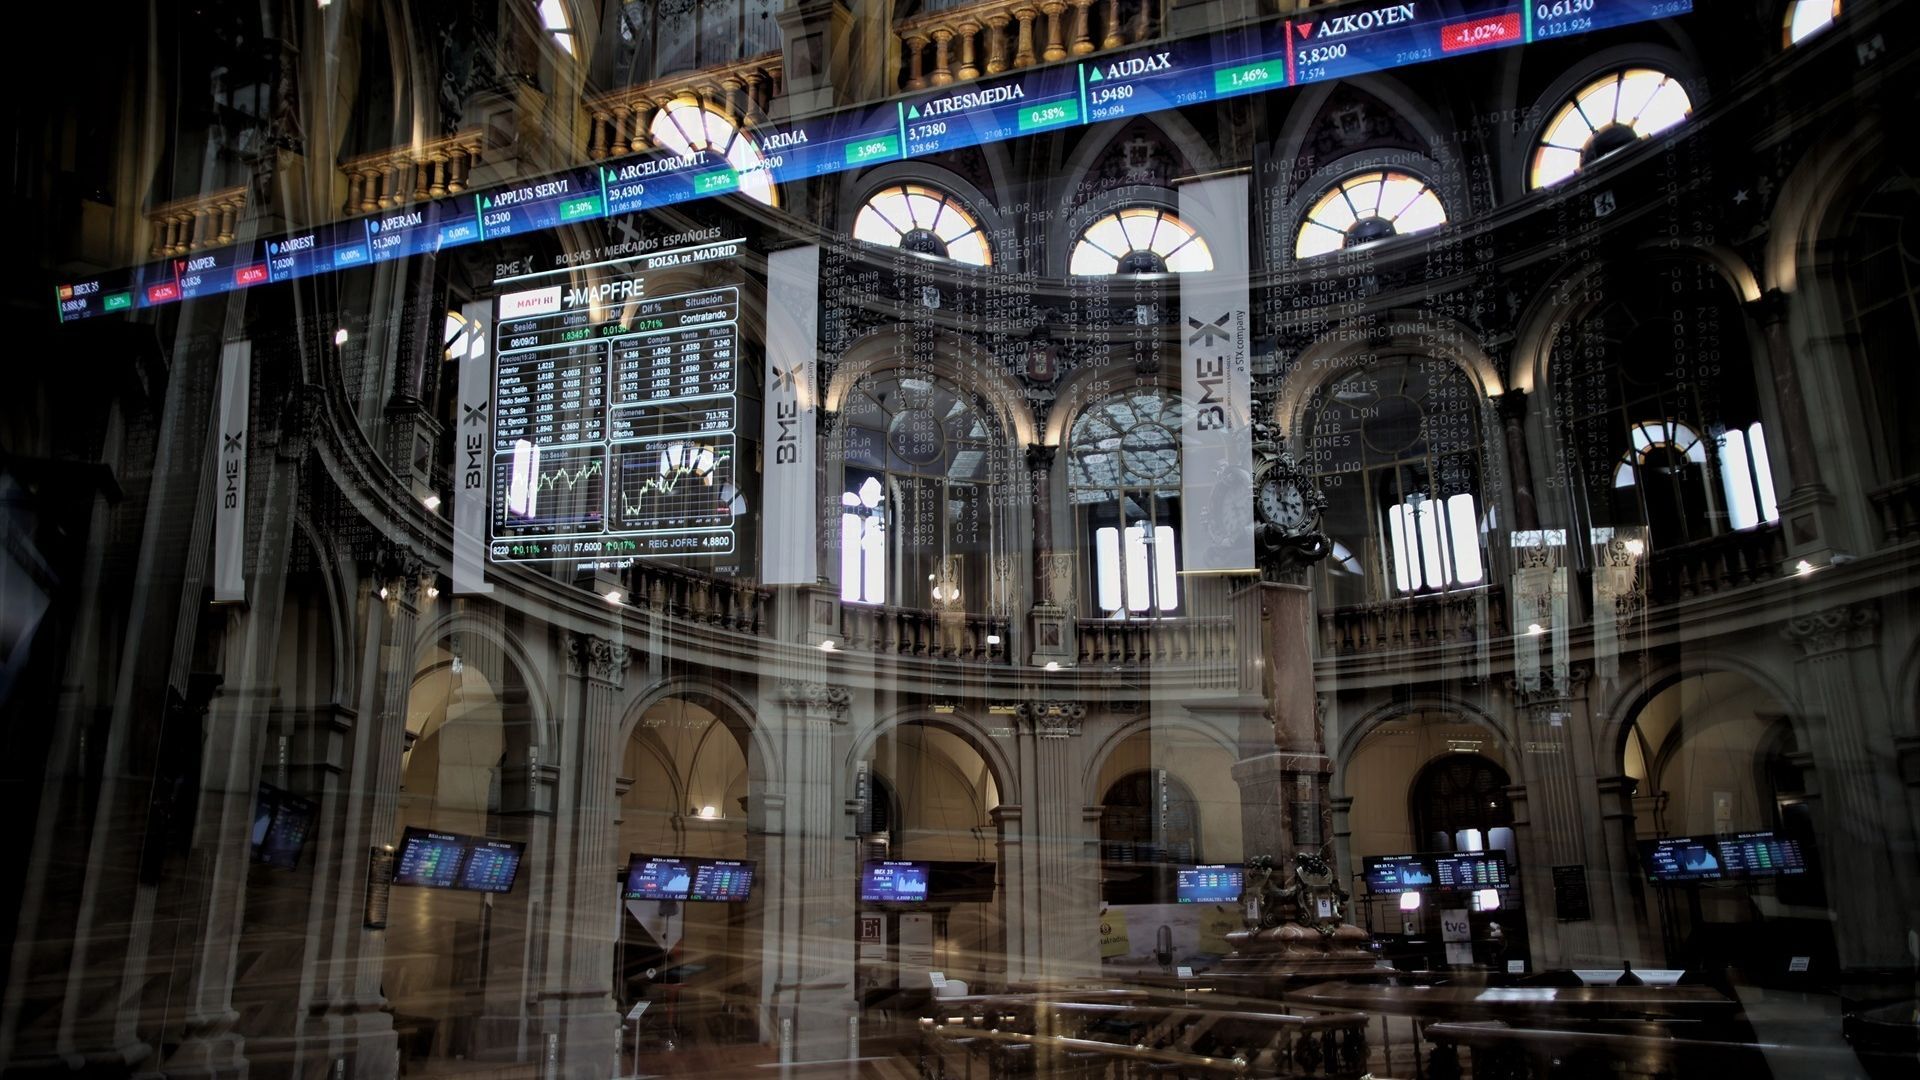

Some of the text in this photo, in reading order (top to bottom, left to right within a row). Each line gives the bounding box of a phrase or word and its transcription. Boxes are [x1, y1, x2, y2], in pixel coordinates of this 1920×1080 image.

[1317, 3, 1415, 38] AZKOYEN
[1538, 18, 1592, 37] 6.121.924
[1456, 22, 1505, 43] -1,02%
[1299, 44, 1347, 65] 5,8200
[1396, 48, 1432, 64] 27/08/21
[1107, 53, 1172, 79] AUDAX
[1231, 69, 1268, 86] 1,46%
[1300, 67, 1325, 81] 7.574
[922, 84, 1025, 117] ATRESMEDIA
[1091, 86, 1133, 105] 1,9480
[1176, 89, 1207, 103] 27/08/21
[1031, 107, 1065, 123] 0,38%
[1092, 104, 1125, 119] 399.094
[908, 122, 946, 140] 3,7380
[762, 129, 808, 151] ARIMA
[910, 140, 939, 154] 328.645
[857, 142, 886, 157] 3,96%
[1264, 155, 1315, 173] INDICE
[1282, 147, 1450, 182] INDICES NACIONALES
[704, 173, 730, 188] 2,74%
[493, 179, 569, 208] APPLUS SERVI
[608, 184, 644, 201] 29,4300
[1117, 187, 1139, 197] DIF
[568, 201, 592, 215] 2,30%
[993, 203, 1031, 216] VALOR
[380, 211, 423, 232] APERAM
[484, 212, 511, 227] 8,2300
[448, 226, 470, 239] 0,00%
[279, 235, 315, 253] AMREST
[372, 234, 401, 250] 51,2600
[555, 226, 722, 265] BOLSAS Y MERCADOS ESPAÑOLES
[340, 248, 360, 261] 0,00%
[648, 244, 738, 269] BOLSA MADRID
[1265, 250, 1375, 273] IBEX 35 ENER
[187, 256, 216, 272] AMPER
[272, 257, 294, 270] 7,0200
[496, 260, 520, 277] BME
[825, 267, 845, 276] CAF
[825, 271, 879, 287] CATALANA
[985, 270, 1038, 286] EDREAMS
[1265, 262, 1375, 286] IBEX 35 CONS
[575, 278, 645, 305] MAPFRE
[825, 283, 879, 298] COR ALBA
[1266, 275, 1375, 298] IBEX TOP DIV
[685, 295, 723, 307] Situación
[825, 294, 879, 308] DOMINION
[985, 295, 1031, 308] ERCROS
[1266, 290, 1367, 311] IB GROWTH15
[642, 305, 653, 314] Dif
[681, 310, 727, 323] Contratando
[985, 306, 1038, 321] EZENTIS
[1265, 302, 1367, 324] LATIBEX TOP
[513, 321, 537, 332] Sesión
[563, 314, 587, 326] Último
[985, 316, 1046, 332] GRENERGY
[1265, 314, 1376, 337] LATIBEX BRAS
[681, 332, 698, 340] Venta
[825, 325, 879, 341] EUSKALTE
[1236, 310, 1246, 350] company
[1313, 319, 1456, 344] INTERNACIONALES
[511, 335, 539, 348] 06/09/21
[647, 335, 671, 345] Compra
[985, 333, 1008, 344] LAR
[1312, 353, 1378, 369] STOXX50
[500, 367, 519, 375] Anterior
[985, 366, 1031, 378] MIQUEL
[499, 377, 520, 386] Apertura
[985, 379, 1008, 389] OHL
[1331, 380, 1379, 394] PARIS
[1196, 356, 1225, 431] BME
[705, 411, 729, 420] 713.752
[1314, 407, 1379, 422] 100 LON
[613, 430, 634, 438] Efectivo
[776, 400, 798, 465] BME
[1314, 423, 1341, 434] MIB
[824, 438, 871, 450] UNICAJA
[1305, 435, 1351, 449] JONES
[466, 433, 482, 490] BME
[824, 449, 871, 461] ZARDOYA
[1305, 451, 1332, 462] 500
[987, 460, 1024, 471] TALGO
[1335, 461, 1361, 473] 100
[224, 459, 238, 509] BME
[987, 470, 1048, 484] TECNICAS
[1325, 476, 1342, 487] 50
[987, 484, 1039, 496] TUBACEX
[986, 495, 1040, 506] VOCENTO
[552, 543, 571, 553] ROVI
[649, 538, 669, 549] REIG
[670, 537, 698, 548] JOFRE
[861, 919, 880, 938] Ei
[1445, 921, 1467, 934] tve
